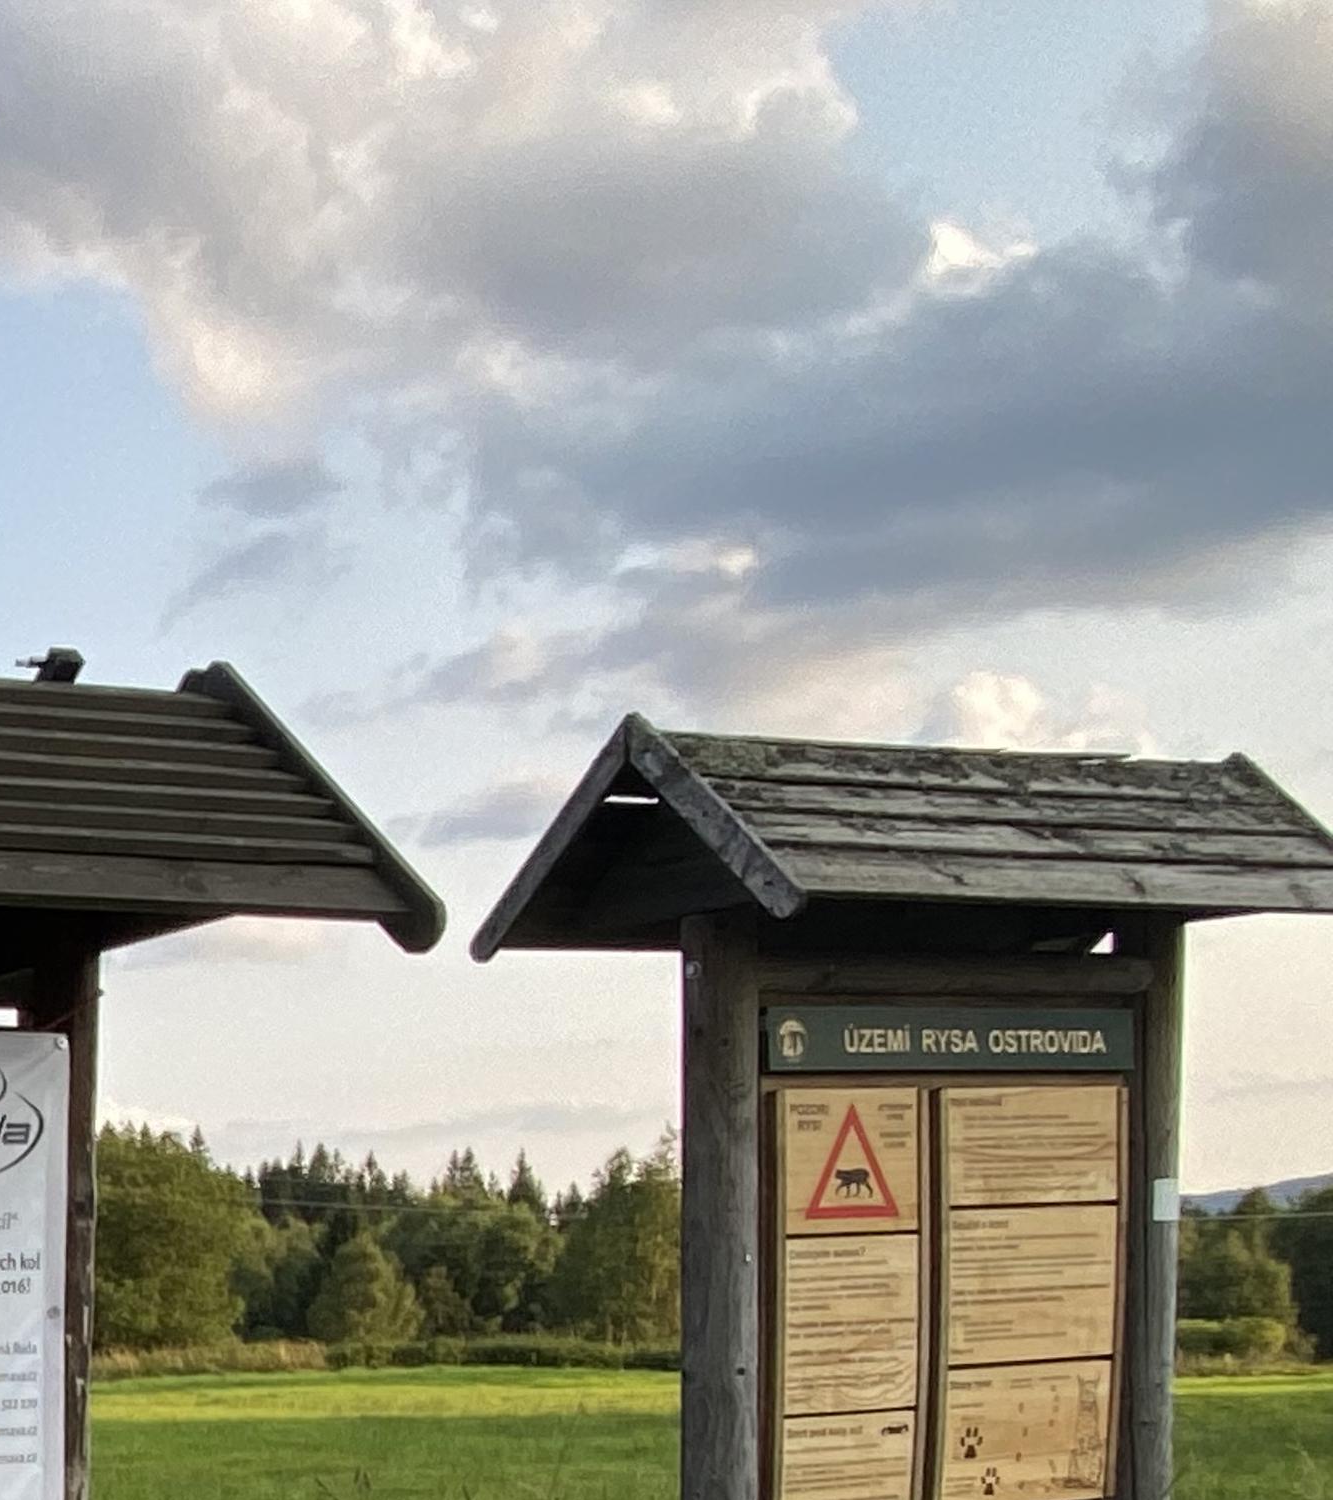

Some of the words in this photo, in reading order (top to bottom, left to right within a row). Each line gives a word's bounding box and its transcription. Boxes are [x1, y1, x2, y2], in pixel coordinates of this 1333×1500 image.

[843, 1023, 911, 1053] ÚZEMÍ
[921, 1028, 980, 1054] RYSA
[988, 1029, 1107, 1055] OSTROVIDA
[19, 1252, 41, 1270] kol
